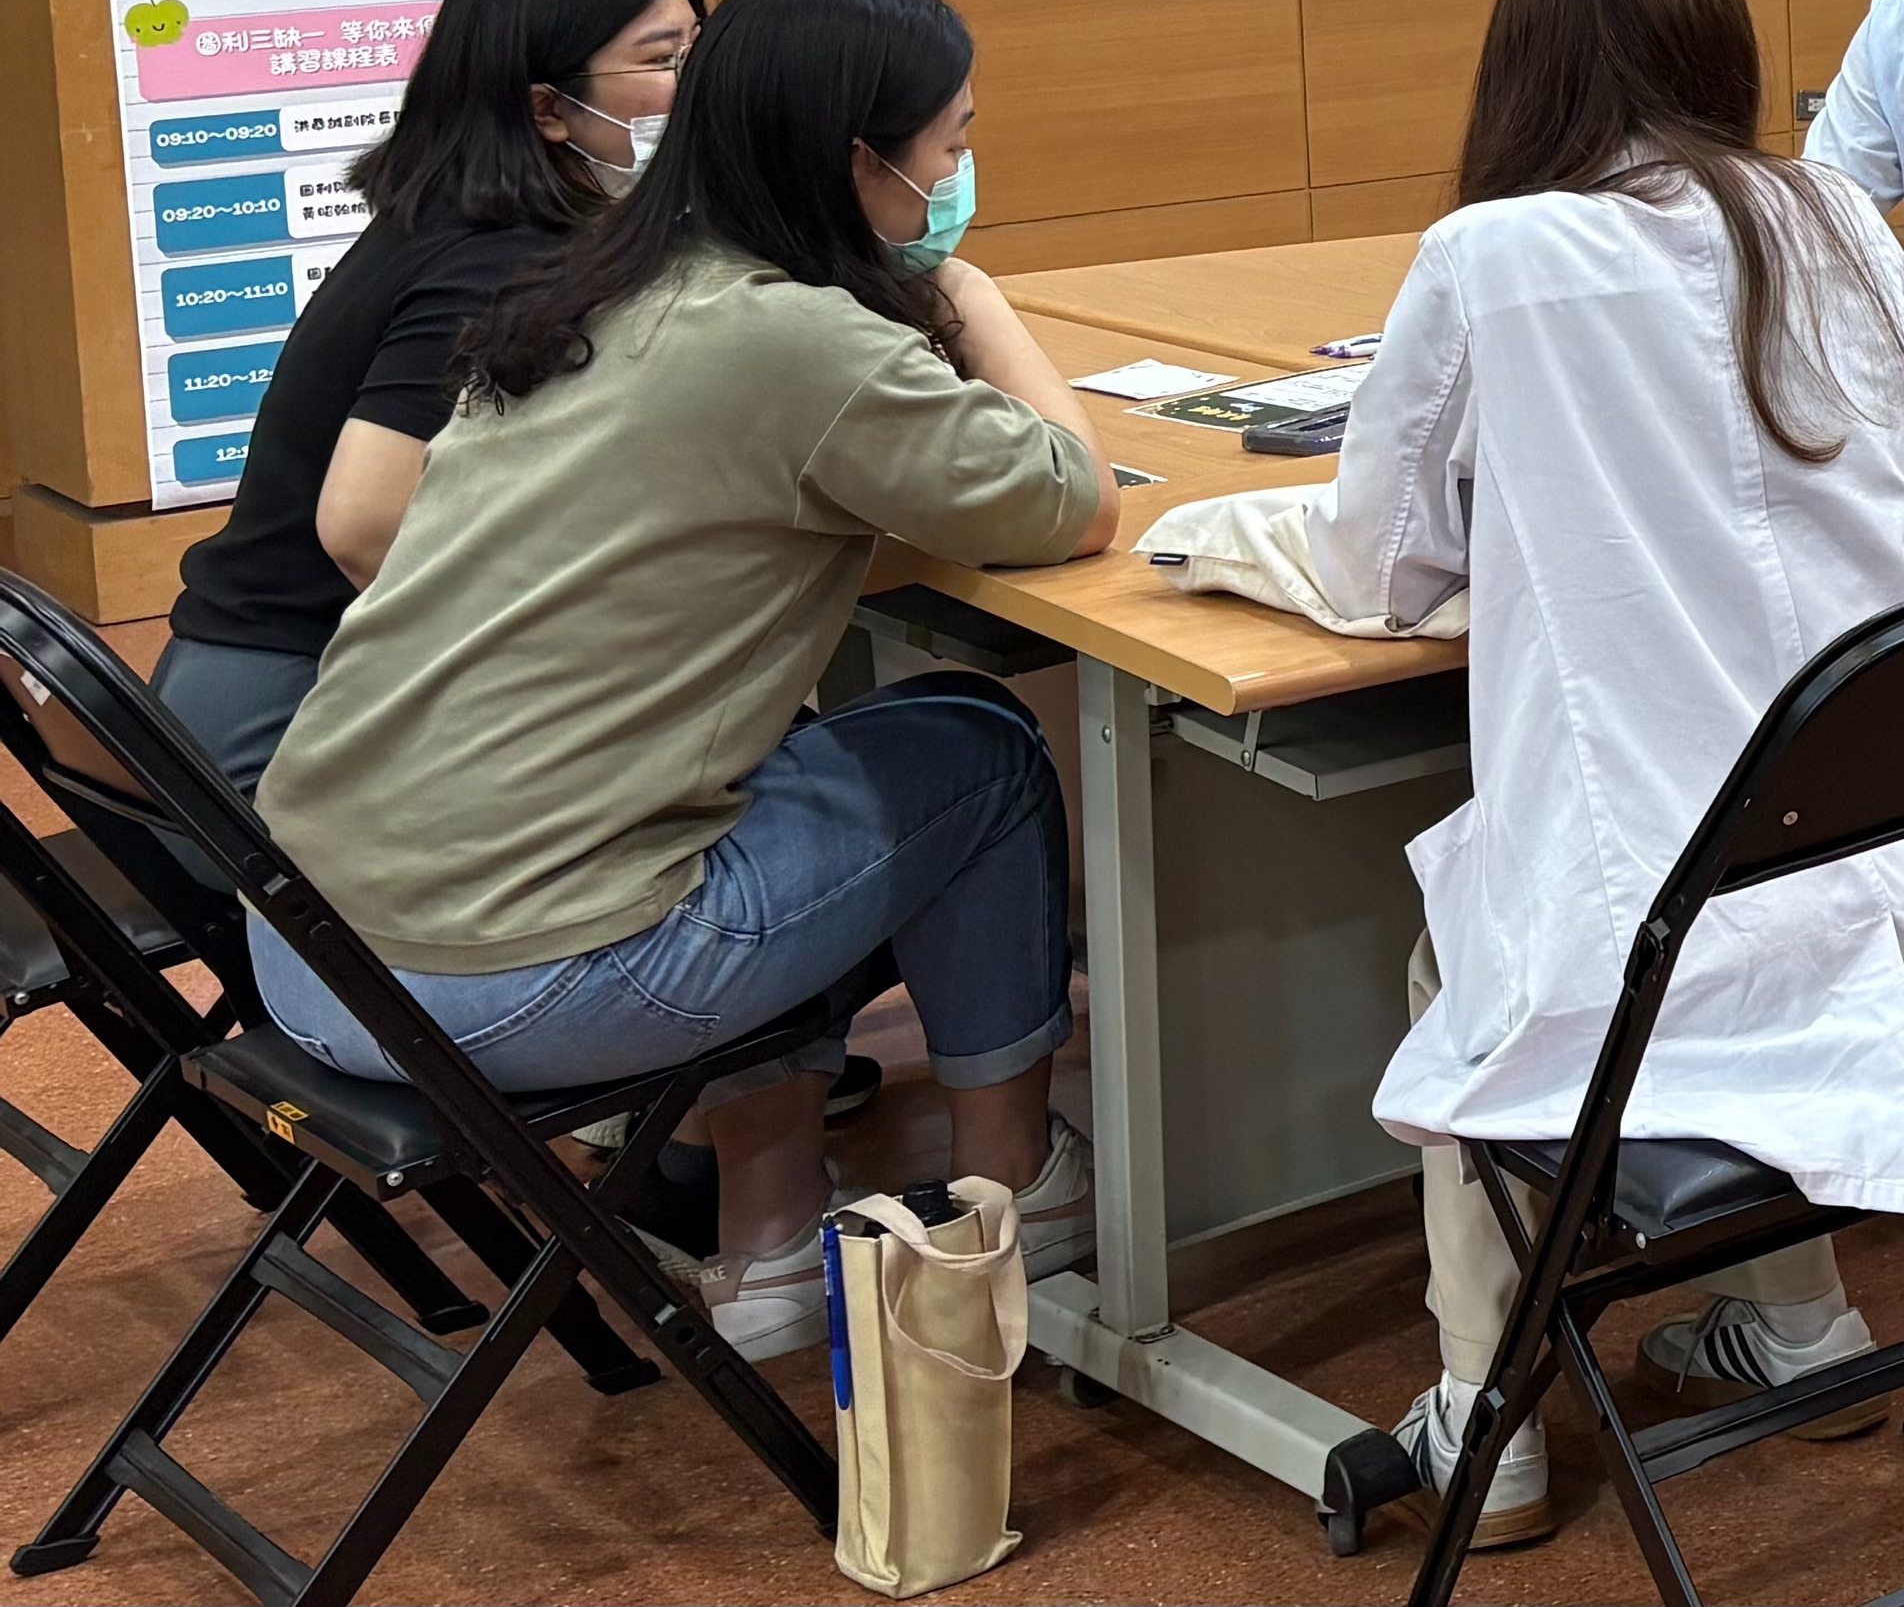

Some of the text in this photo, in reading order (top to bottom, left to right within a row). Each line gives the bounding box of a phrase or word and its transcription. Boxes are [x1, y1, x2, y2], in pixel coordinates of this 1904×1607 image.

[270, 44, 399, 76] 講習課程表
